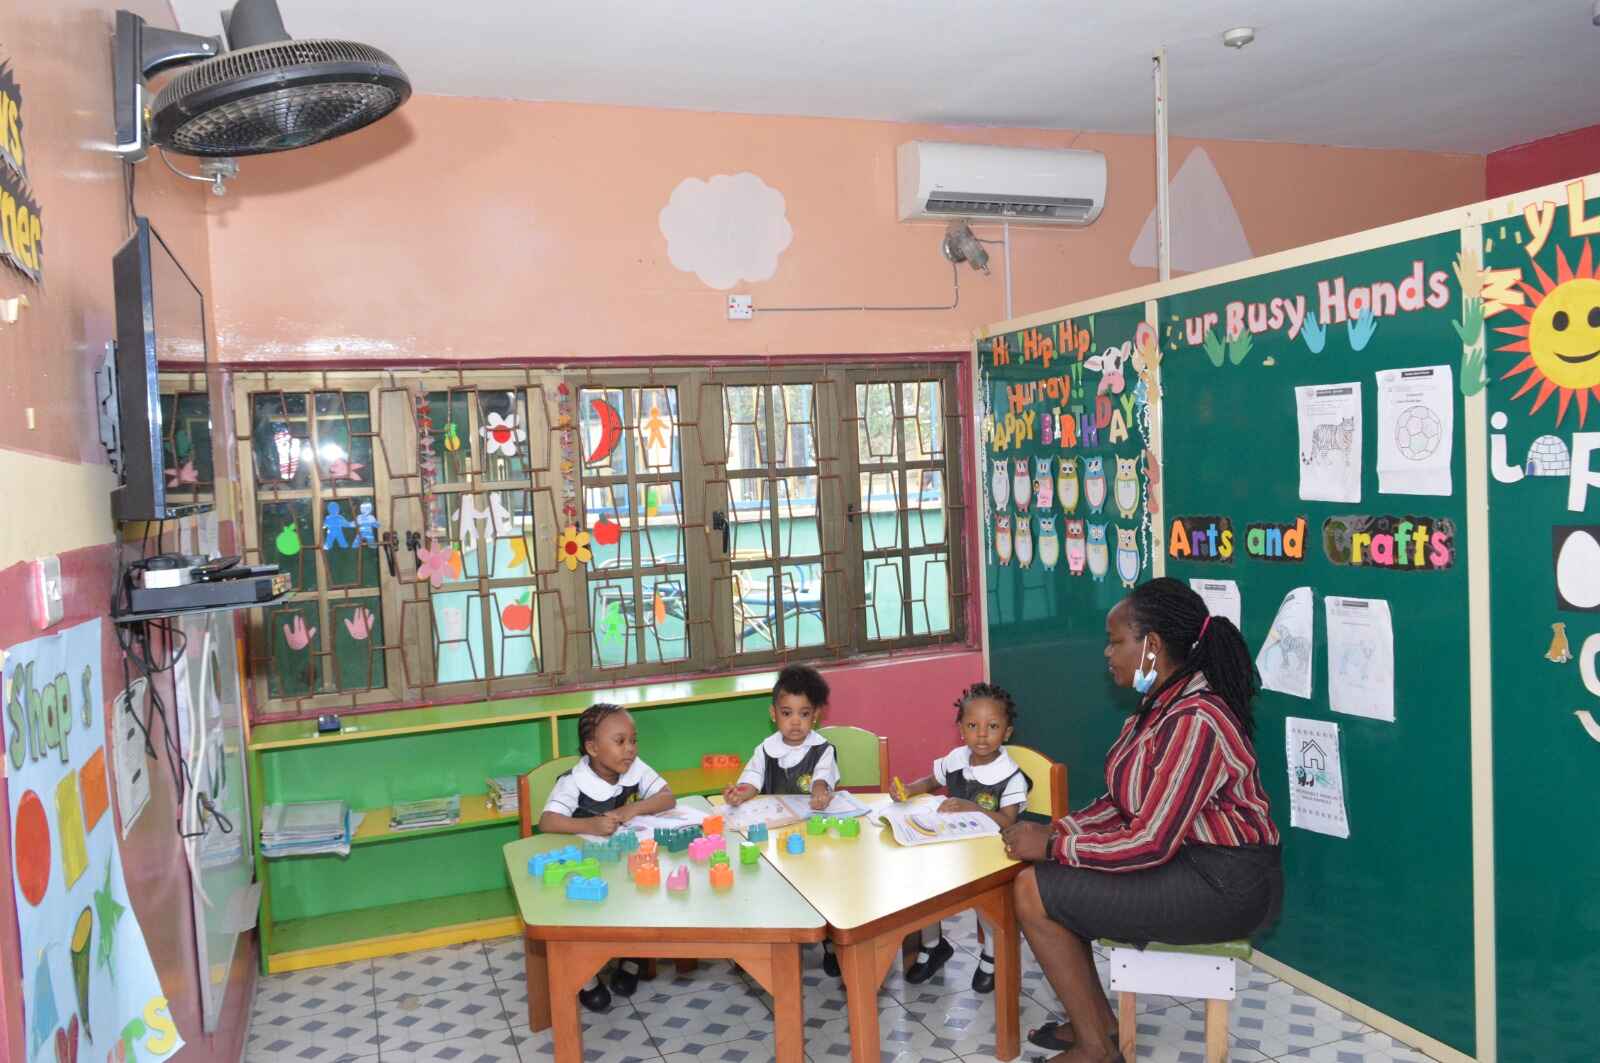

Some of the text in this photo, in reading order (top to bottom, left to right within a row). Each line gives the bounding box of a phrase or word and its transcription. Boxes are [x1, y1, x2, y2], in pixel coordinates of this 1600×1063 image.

[0, 187, 41, 271] ner
[1225, 294, 1305, 341] Busy
[1317, 260, 1450, 326] Hands
[1169, 519, 1233, 558] Arts
[1247, 517, 1306, 558] and
